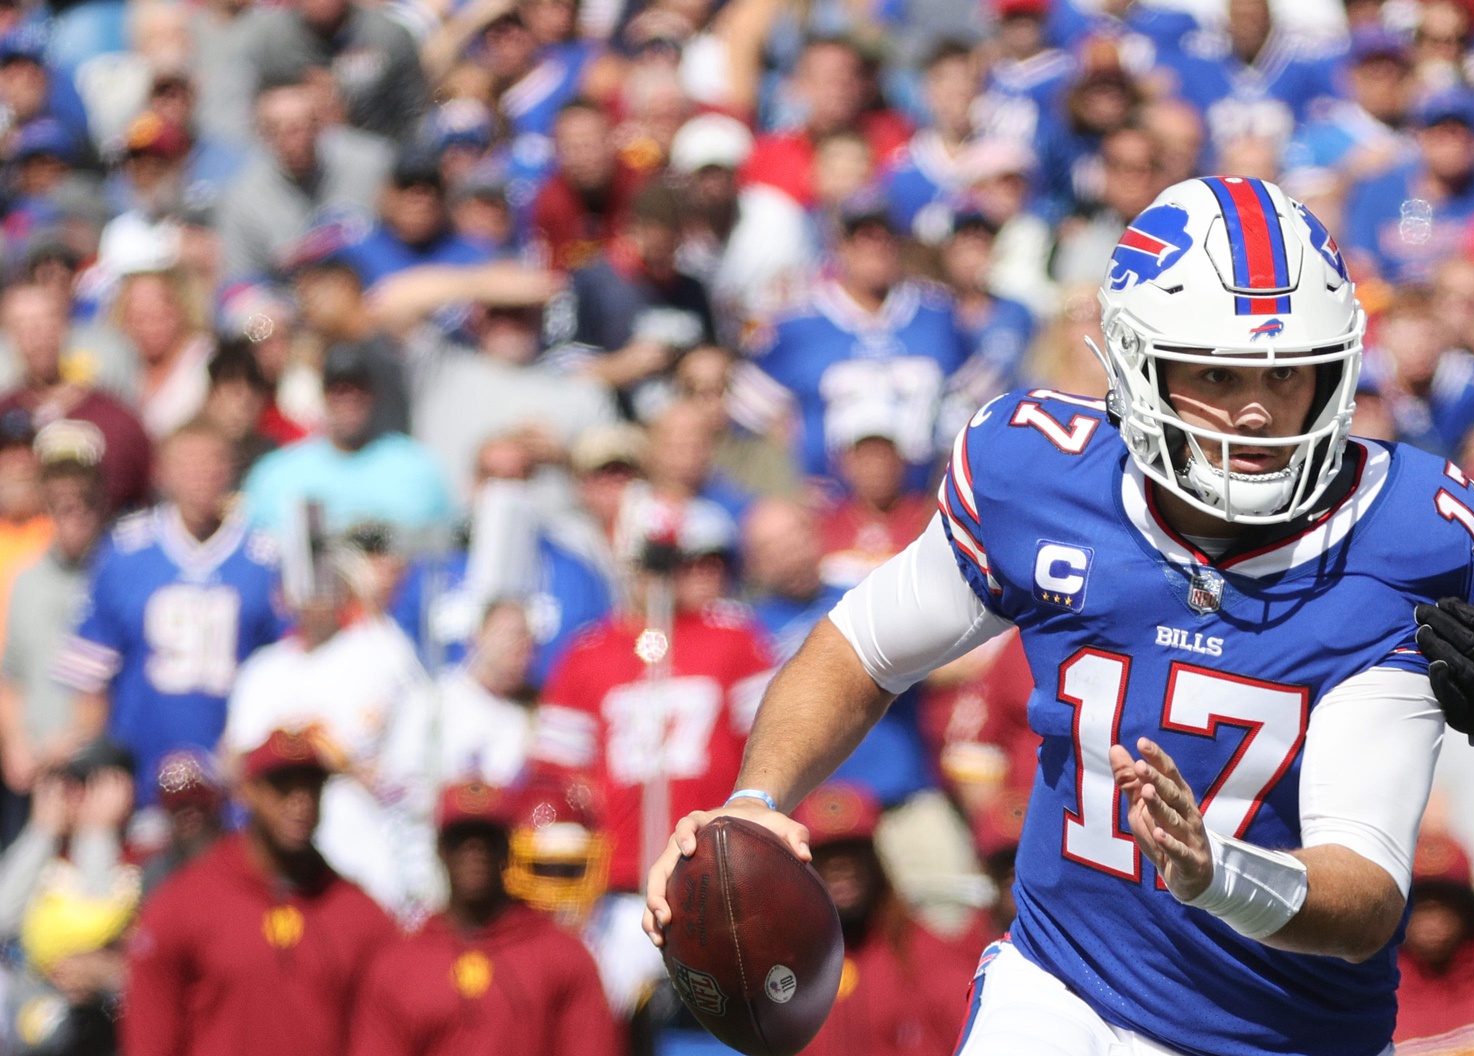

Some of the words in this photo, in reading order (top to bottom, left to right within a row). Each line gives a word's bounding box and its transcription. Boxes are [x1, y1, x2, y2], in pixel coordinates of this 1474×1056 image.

[1034, 544, 1087, 595] C
[1155, 626, 1224, 657] BILLS
[1056, 644, 1311, 891] 17
[690, 976, 719, 1012] NFL
[780, 975, 796, 993] 110
